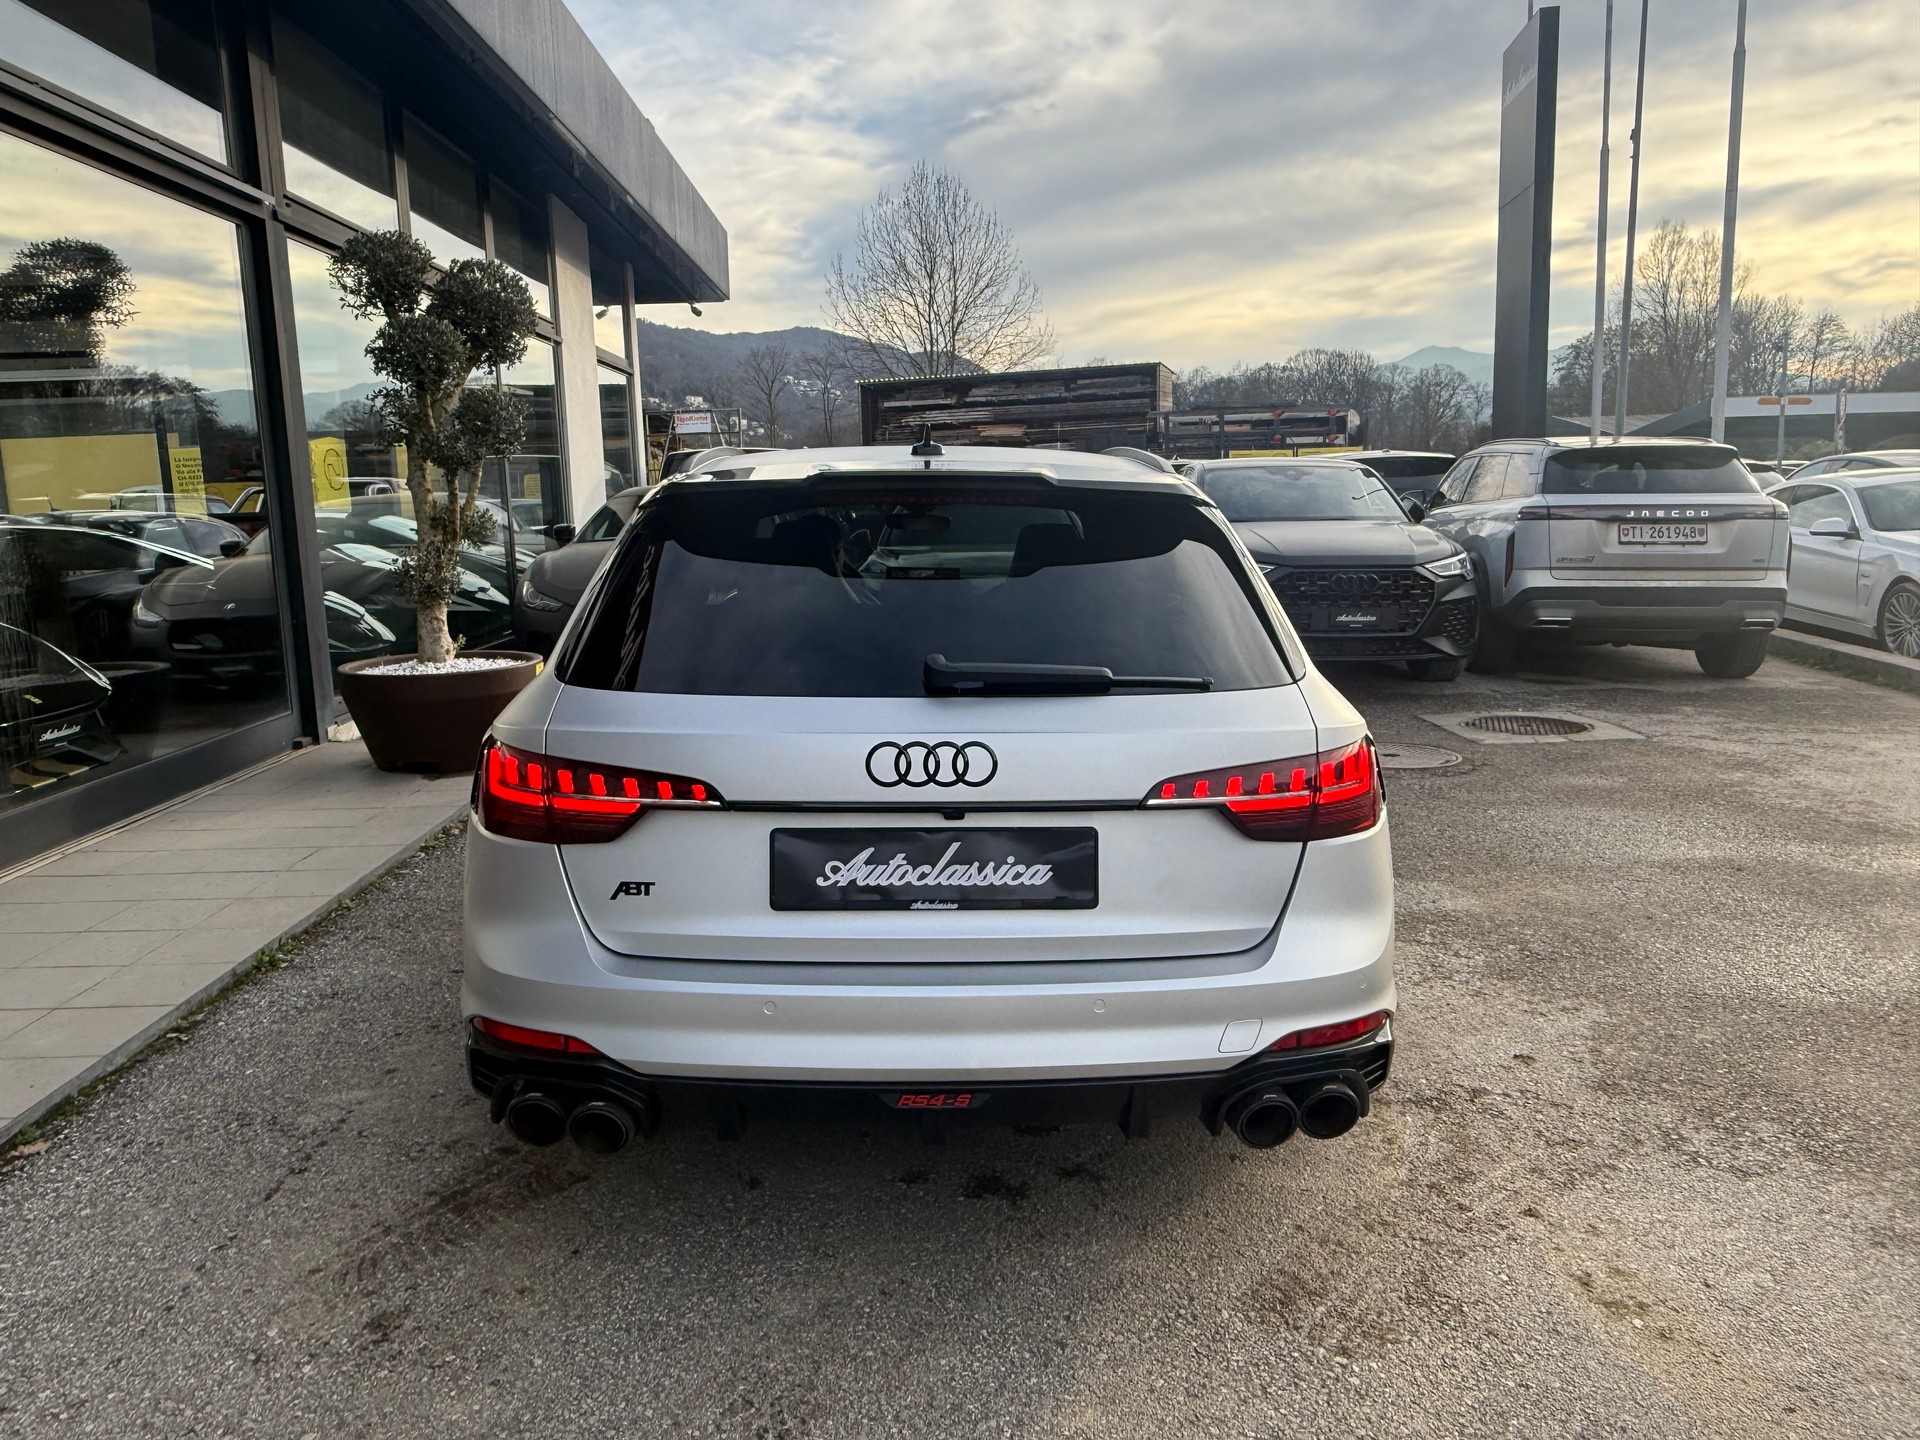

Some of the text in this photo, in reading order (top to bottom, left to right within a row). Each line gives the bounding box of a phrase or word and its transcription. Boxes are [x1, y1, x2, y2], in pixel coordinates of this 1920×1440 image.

[816, 842, 1053, 887] Autoclassica
[610, 881, 656, 900] ABT
[898, 1094, 972, 1107] RS4-S
